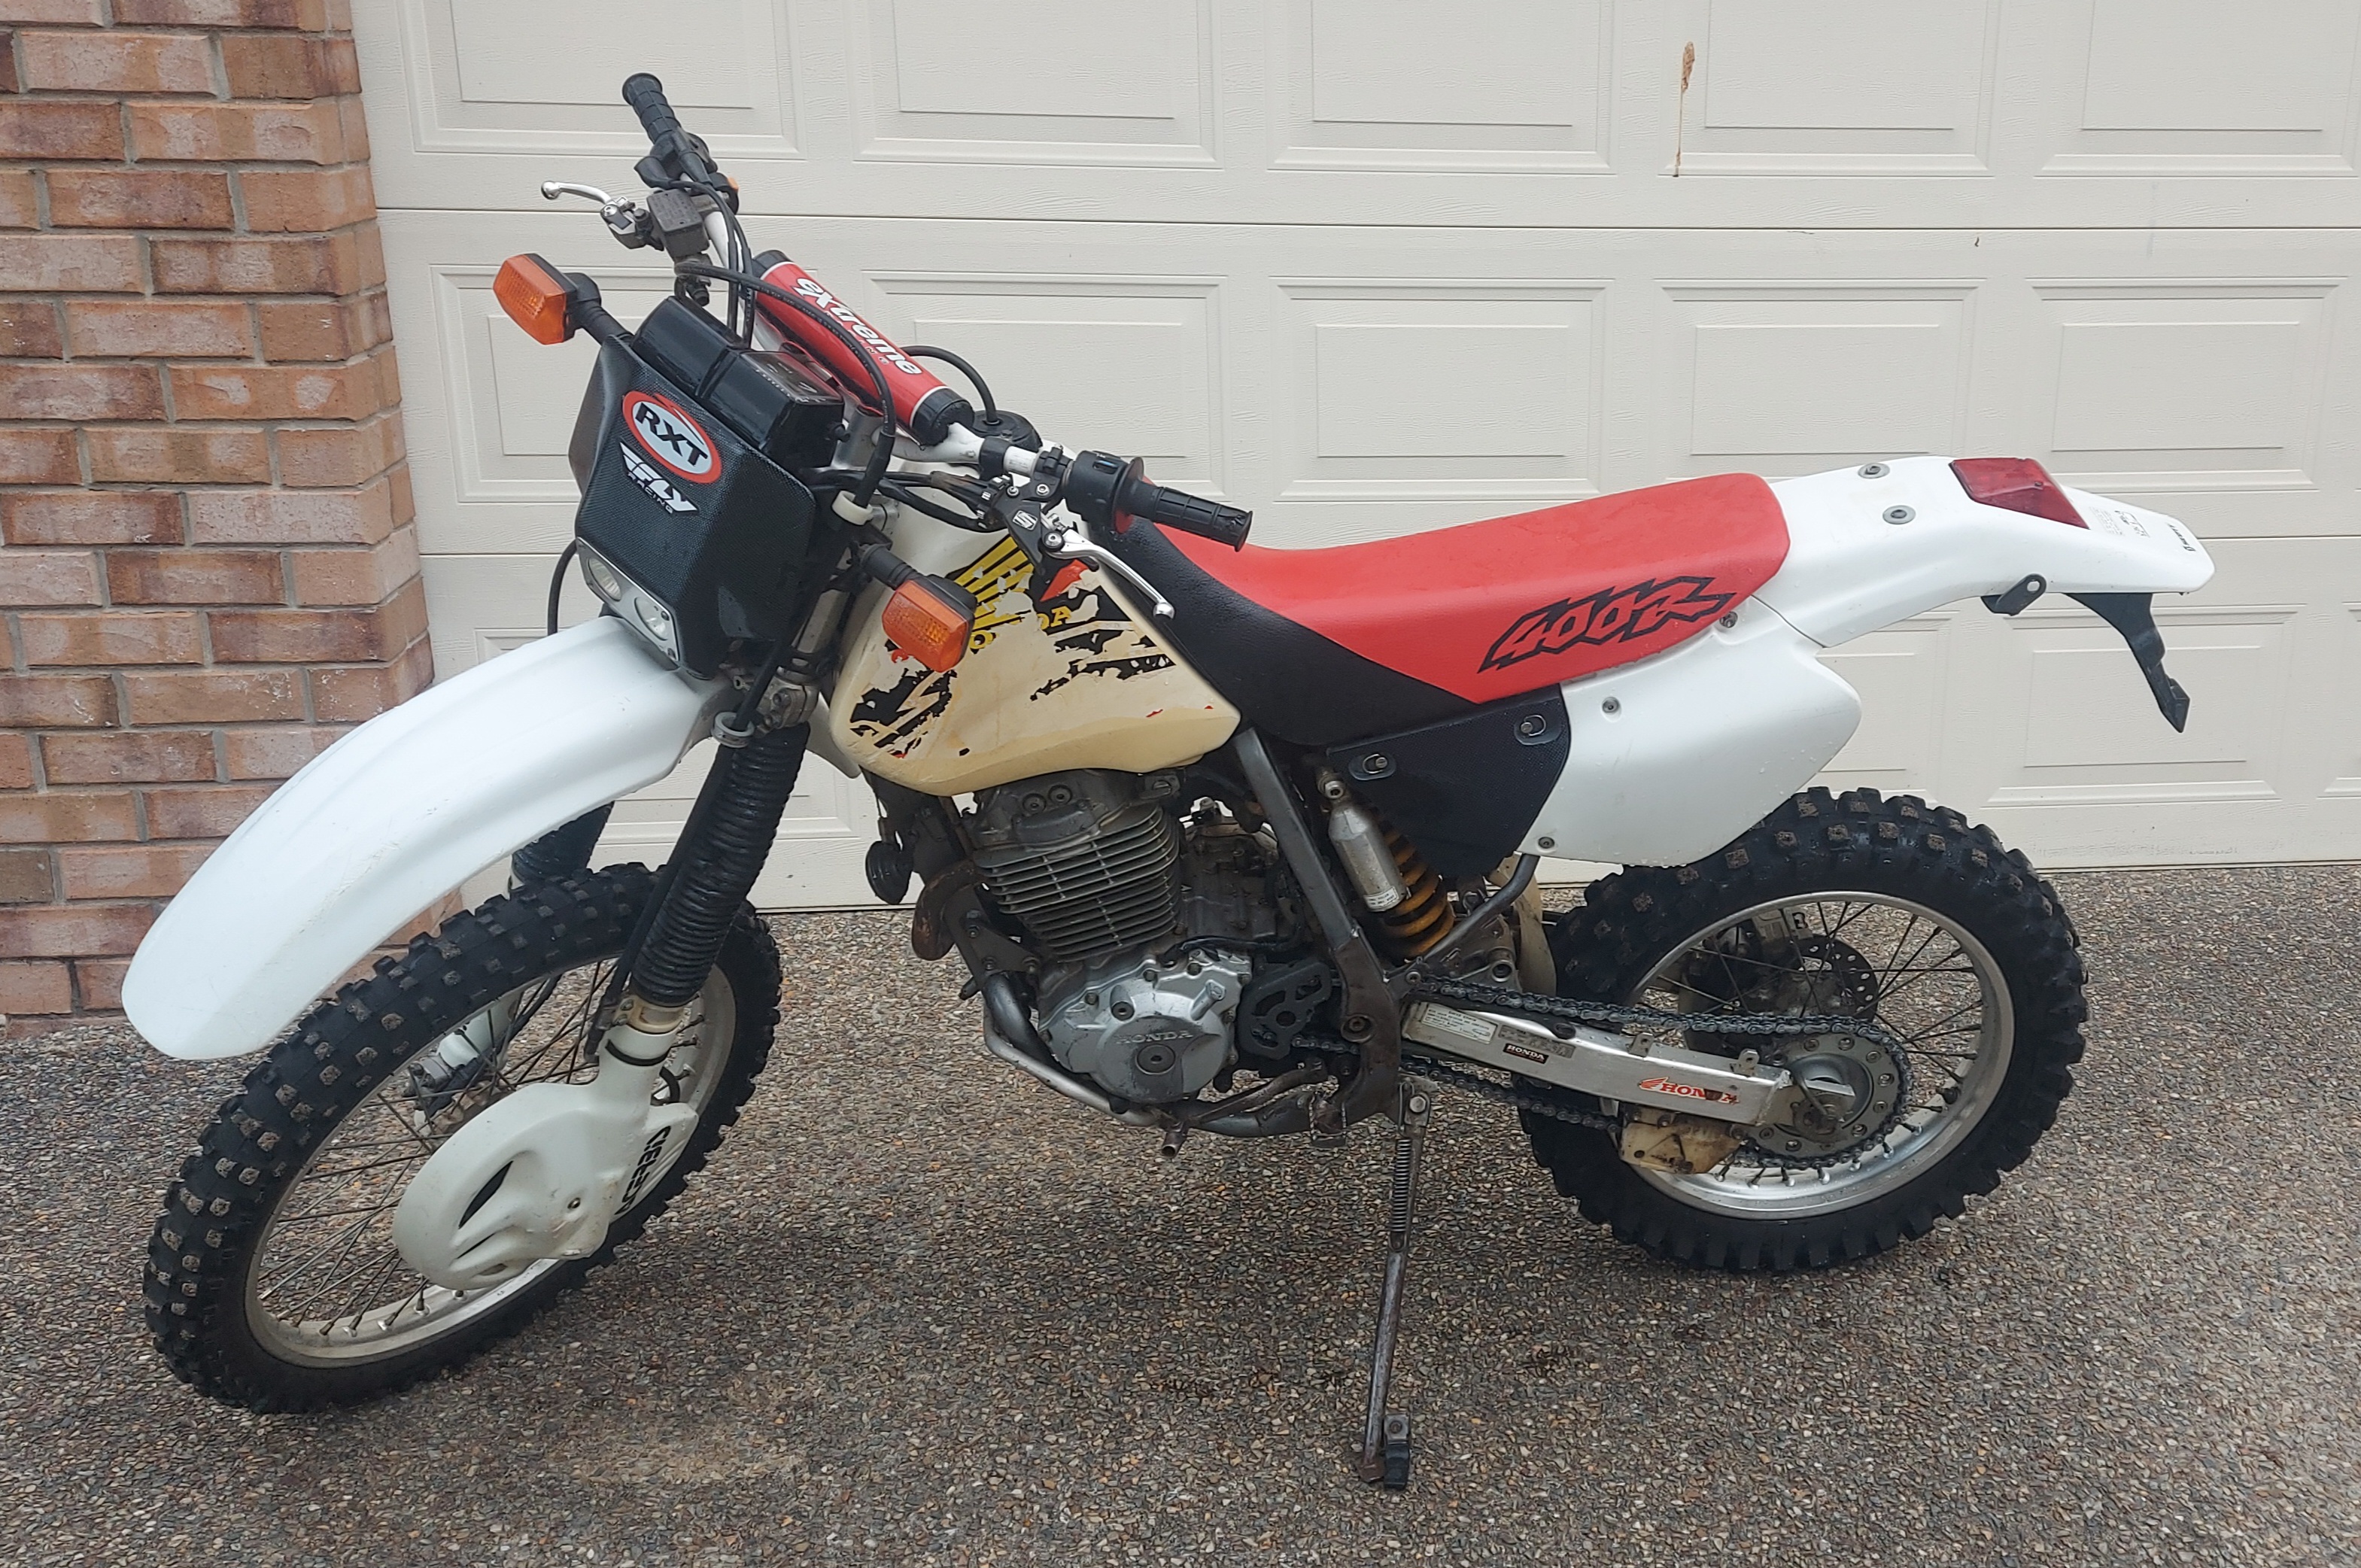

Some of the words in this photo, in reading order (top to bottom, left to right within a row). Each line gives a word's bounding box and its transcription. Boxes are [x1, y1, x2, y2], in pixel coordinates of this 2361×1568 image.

[792, 278, 923, 375] extreme
[635, 402, 709, 466] RXT
[626, 456, 698, 512] FLY
[627, 472, 673, 515] RACING
[1477, 576, 1738, 674] 400R
[1115, 1029, 1194, 1044] HONDA
[1506, 1044, 1545, 1062] HONDA
[1659, 1082, 1740, 1105] HONA
